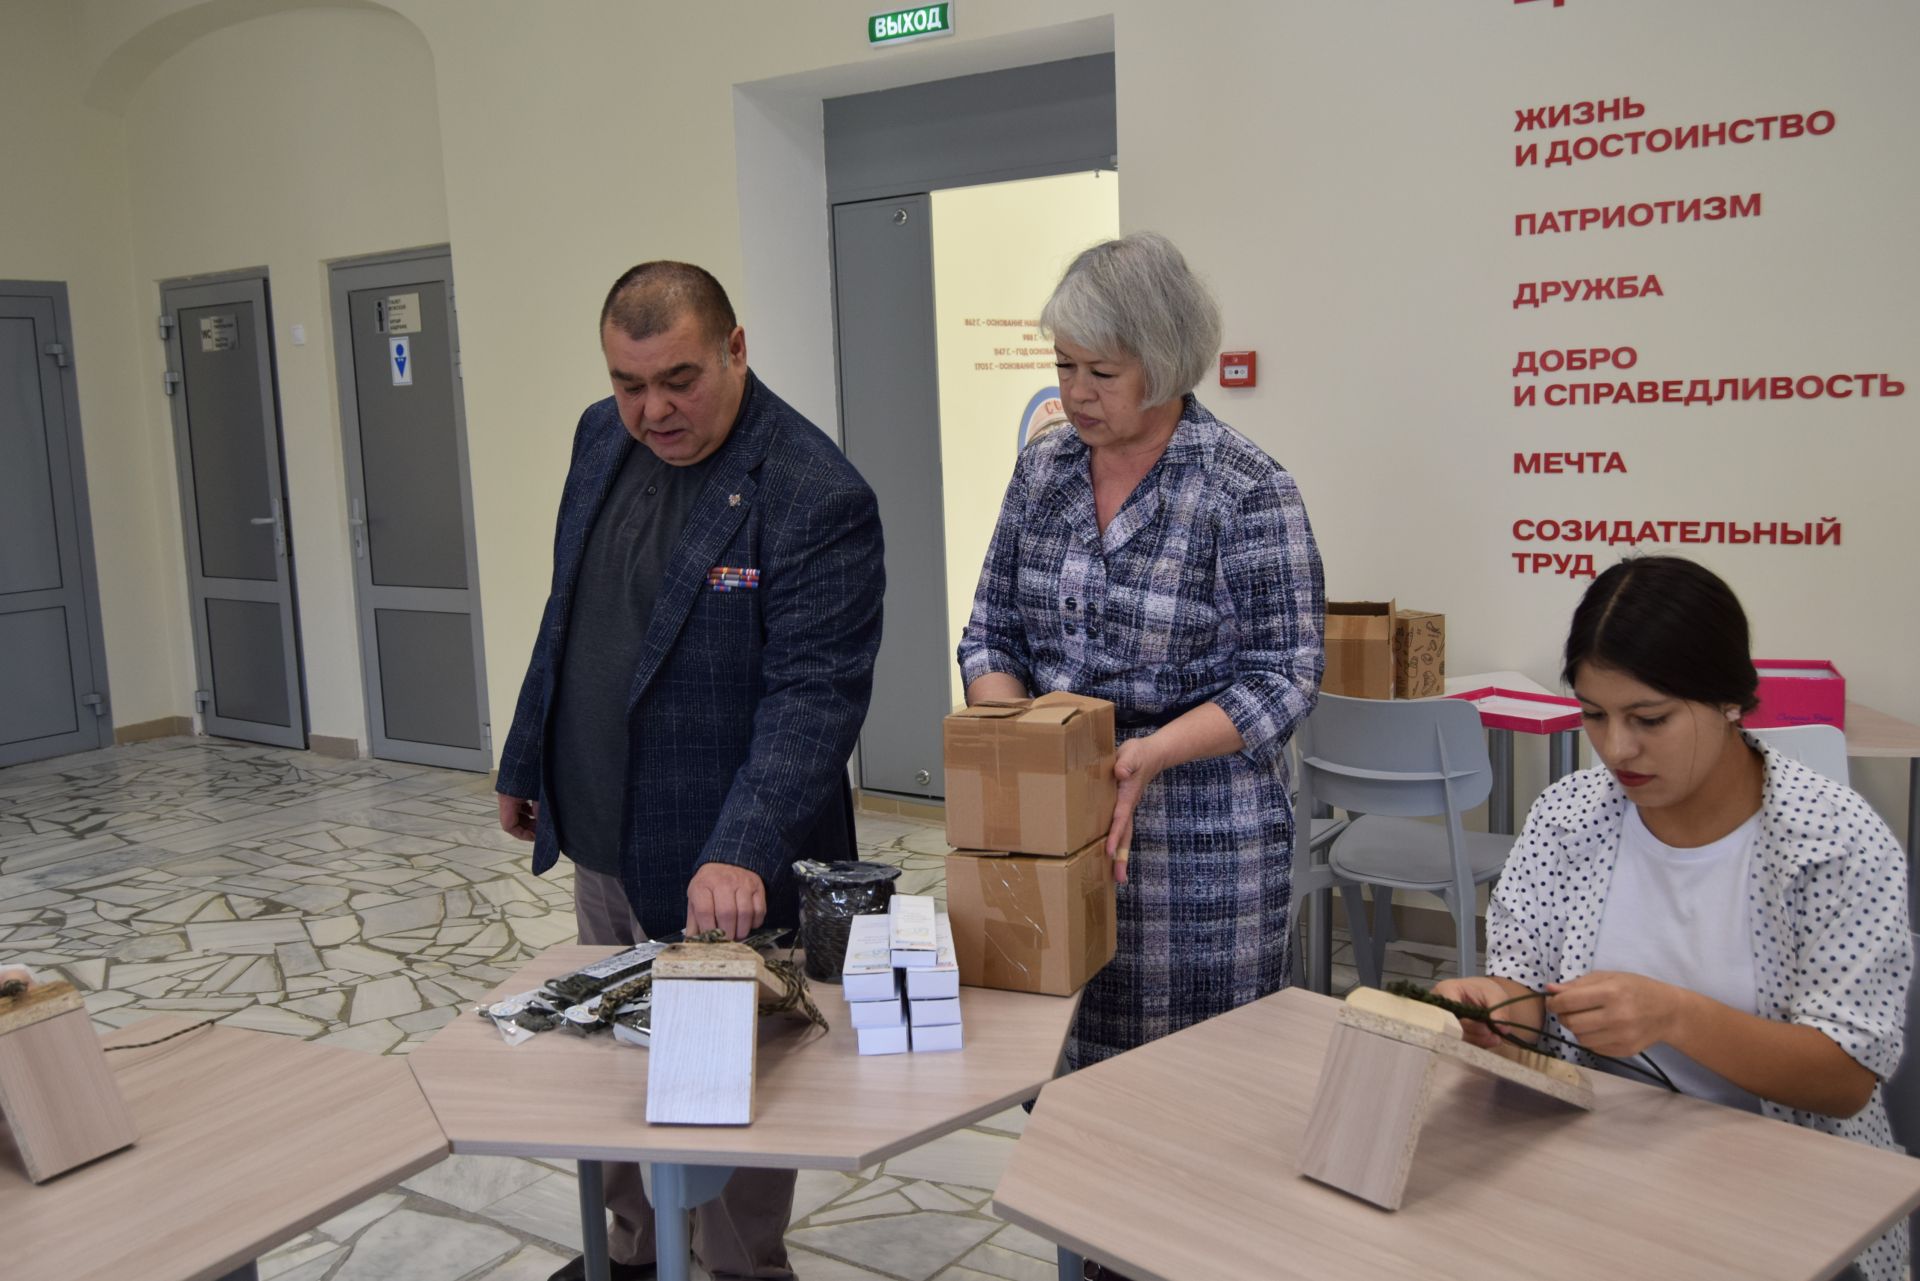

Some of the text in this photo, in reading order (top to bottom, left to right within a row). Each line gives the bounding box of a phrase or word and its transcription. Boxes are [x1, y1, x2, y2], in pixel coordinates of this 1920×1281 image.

[874, 6, 942, 38] ВЫХОД
[1514, 96, 1645, 132] ЖИЗНЬ
[1514, 110, 1836, 168] И ДОСТОИНСТВО
[1514, 193, 1762, 237] ПАТРИОТИЗМ
[1512, 274, 1664, 310] ДРУЖБА
[1512, 346, 1638, 376] ДОБРО
[1513, 373, 1905, 407] И СПРАВЕДЛИВОСТЬ
[1513, 451, 1628, 474] МЕЧТА
[1512, 517, 1842, 546] СОЗИДАТЕЛЬНЫЙ
[1512, 552, 1596, 579] ТРУД
